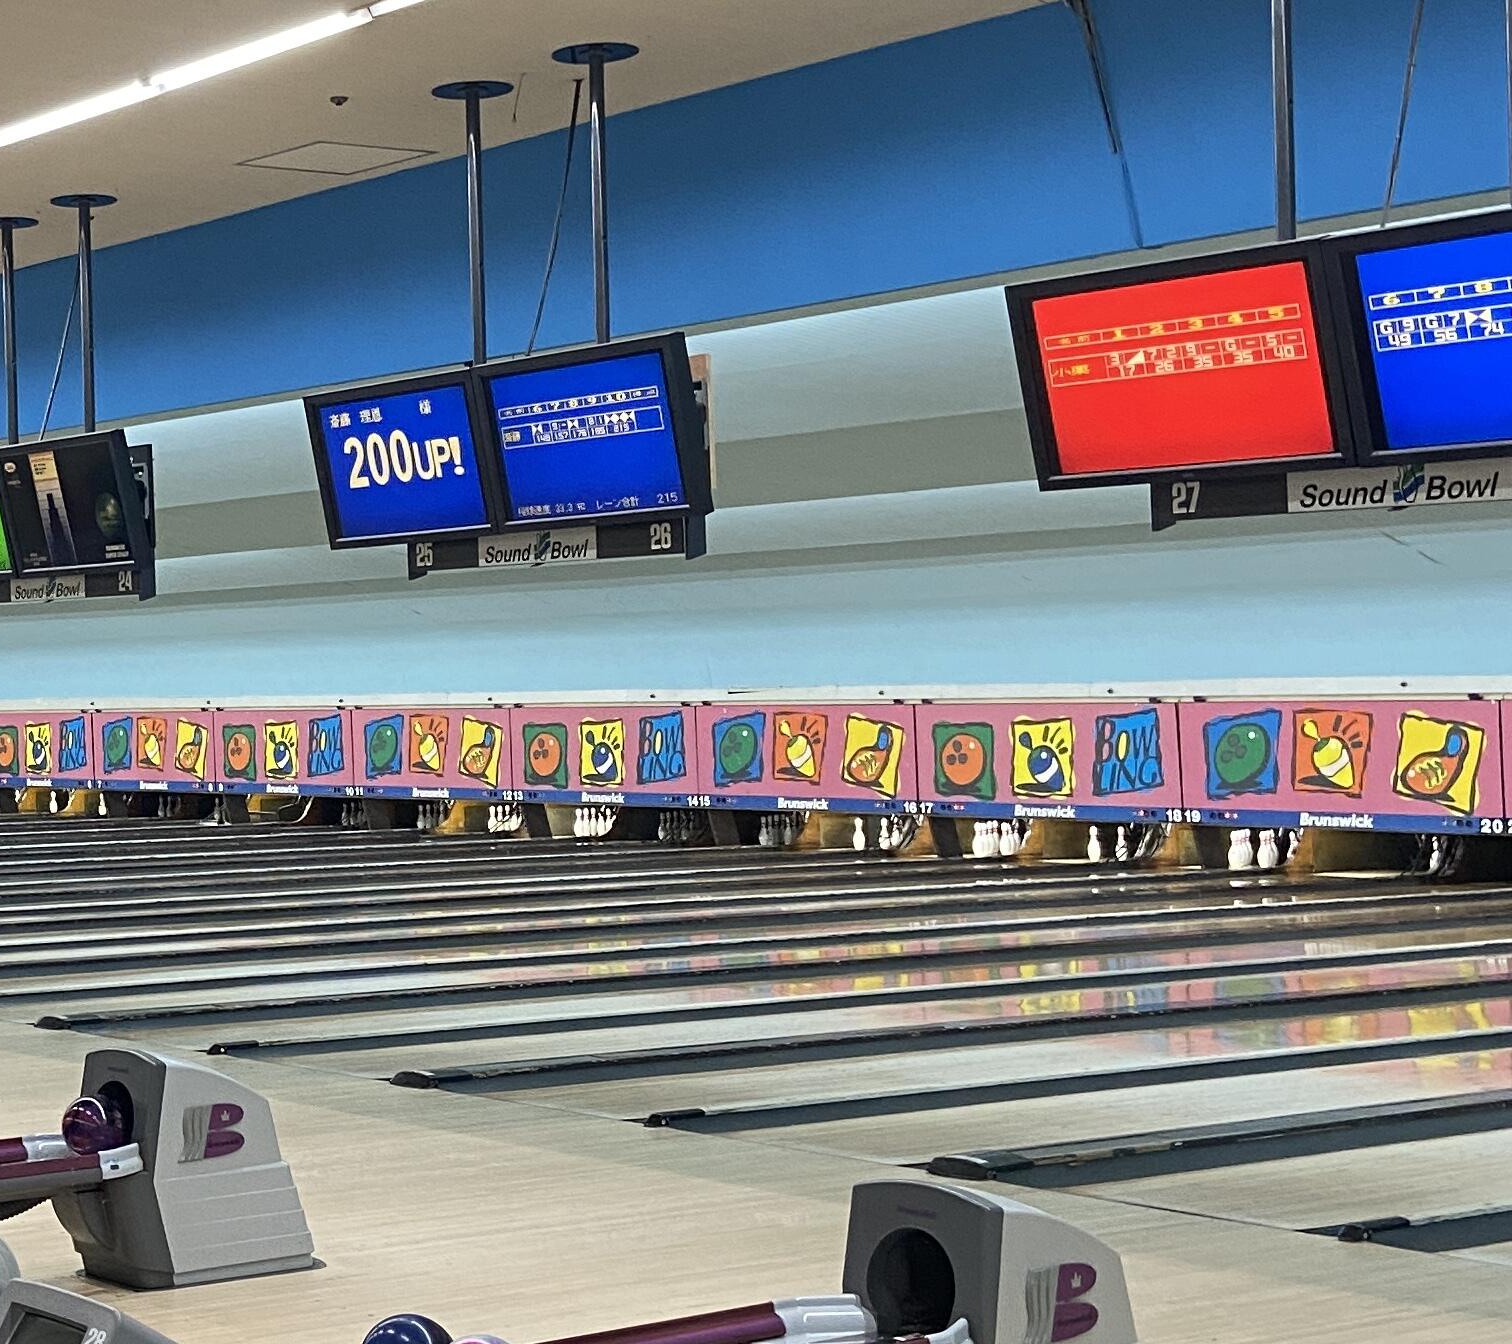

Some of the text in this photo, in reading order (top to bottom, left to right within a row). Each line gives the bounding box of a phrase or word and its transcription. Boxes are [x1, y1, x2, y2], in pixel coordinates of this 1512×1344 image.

[1113, 329, 1125, 340] 1
[1149, 324, 1164, 335] 2
[1189, 318, 1203, 330] 3
[1228, 312, 1242, 324] 4
[1269, 307, 1284, 319] 5
[1388, 334, 1412, 346] 49
[1434, 330, 1457, 342] 56
[1119, 364, 1136, 377] 17
[1156, 360, 1174, 372] 26
[1194, 356, 1214, 368] 35
[1234, 351, 1254, 364] 35
[1273, 346, 1296, 358] 40
[344, 429, 465, 489] 200UP!
[656, 492, 678, 504] 215
[1171, 471, 1500, 514] 27 Sound Bowl
[415, 523, 672, 567] 25 Sound Bowl 26
[14, 585, 45, 600] Sound
[56, 582, 81, 598] Bowl
[118, 571, 133, 592] 24
[640, 719, 682, 755] BOW
[1096, 719, 1158, 763] BOW
[581, 792, 625, 804] Brunswick
[687, 796, 698, 806] 14
[699, 796, 917, 813] 15 Brunswick 16
[920, 802, 1183, 822] 17 Brunswick 18
[1184, 810, 1504, 834] 19 Brunswick 20
